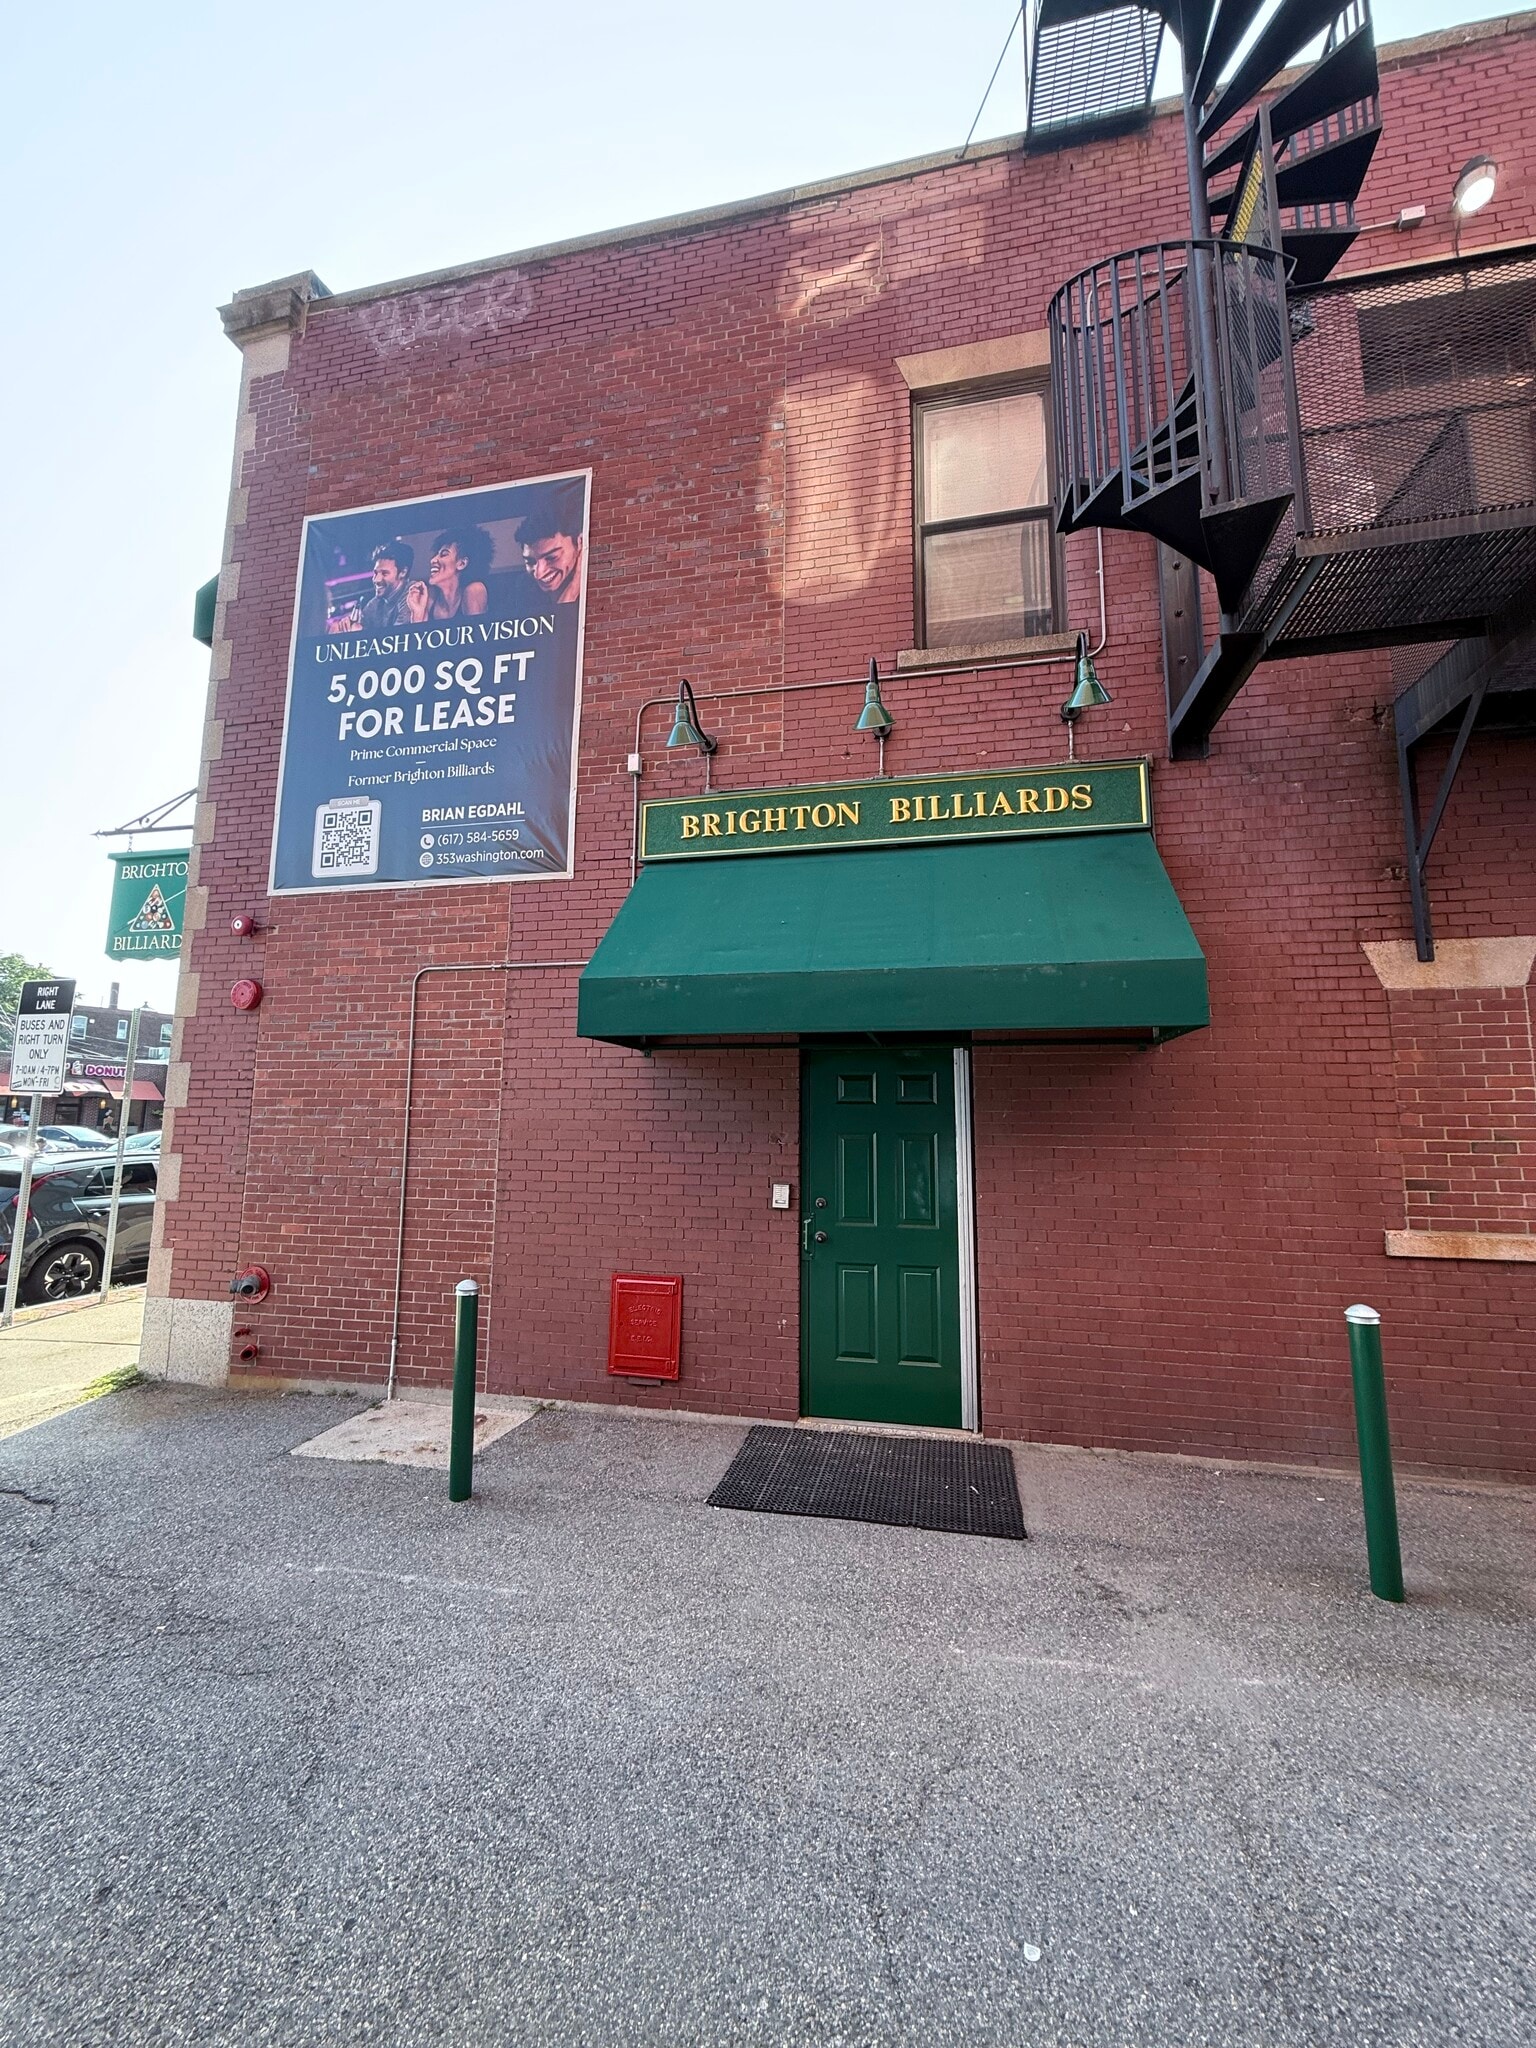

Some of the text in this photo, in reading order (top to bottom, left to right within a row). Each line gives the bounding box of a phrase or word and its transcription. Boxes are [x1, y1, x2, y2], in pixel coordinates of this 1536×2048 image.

[315, 615, 555, 663] UNLEASH YOUR VISION
[327, 650, 535, 707] 5,000 SQ FT
[338, 693, 517, 741] FOR LEASE
[350, 737, 497, 761] Prime Commercial Space
[348, 761, 495, 787] Former Brighton Billiards
[422, 802, 525, 822] BRIAN EGDAHL
[680, 784, 1093, 840] BRIGHTON BILLIARDS
[437, 829, 520, 847] (617) 584-5659
[436, 849, 544, 865] 353washington.com
[121, 862, 189, 879] BRIGHTO
[113, 934, 182, 951] BILLIARD
[37, 986, 59, 997] RIGHT
[36, 1000, 56, 1010] LANE
[20, 1019, 65, 1030] BUSES AND
[18, 1034, 64, 1045] RIGHT TURN
[29, 1048, 49, 1060] ONLY
[86, 1064, 126, 1077] DONUT
